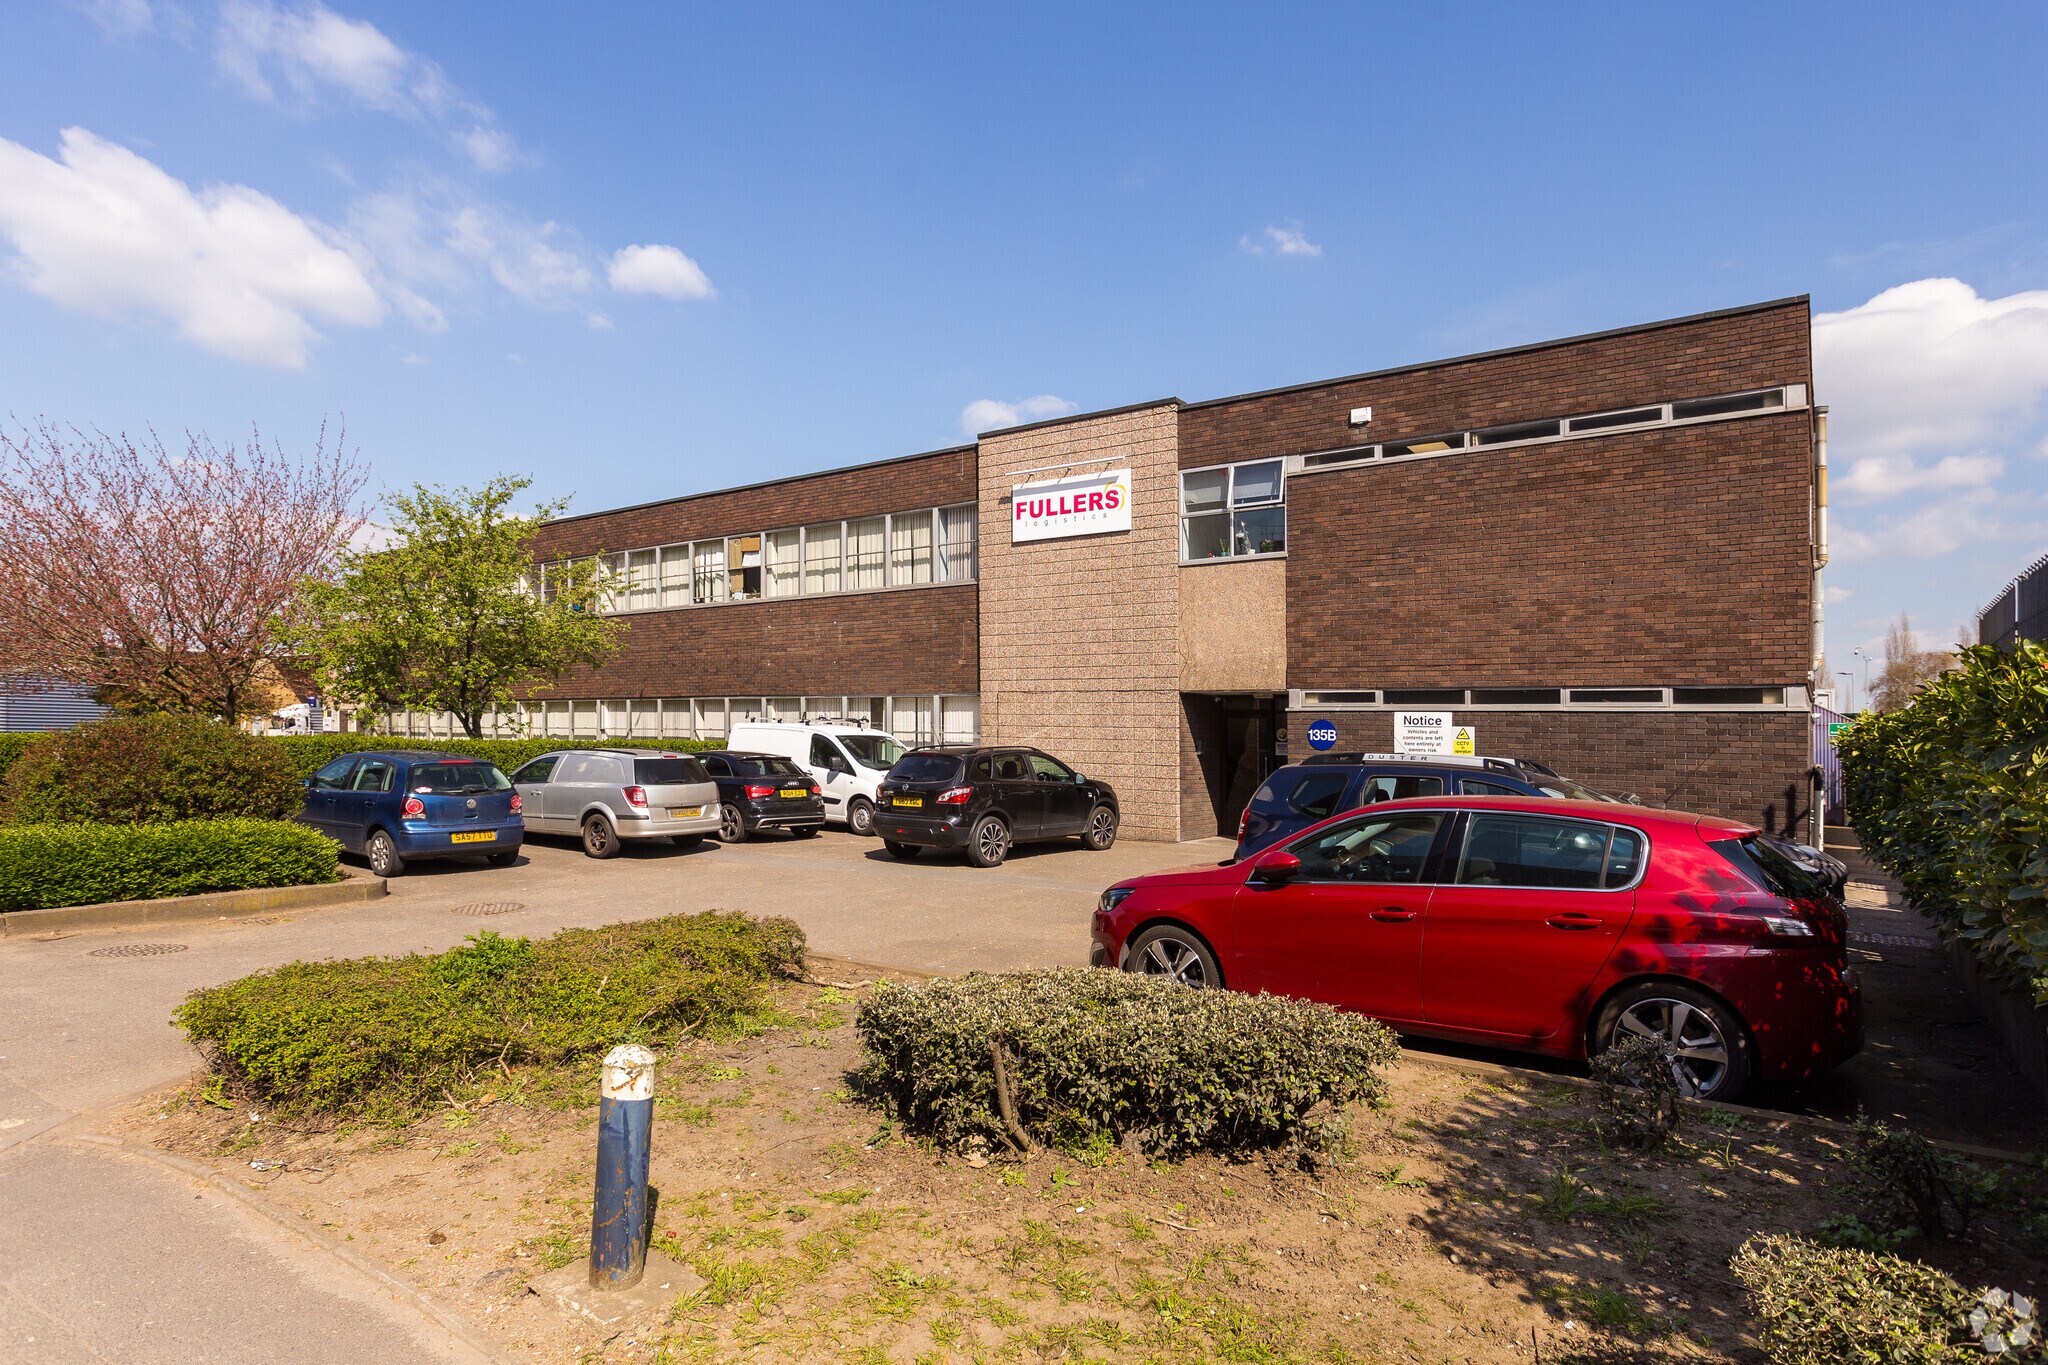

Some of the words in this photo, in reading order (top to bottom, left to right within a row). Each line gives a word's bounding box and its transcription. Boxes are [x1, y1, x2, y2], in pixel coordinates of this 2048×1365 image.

[1016, 489, 1120, 521] FULLERS
[1024, 512, 1108, 528] logistics
[1403, 715, 1442, 726] Notice
[1308, 729, 1337, 741] 135B
